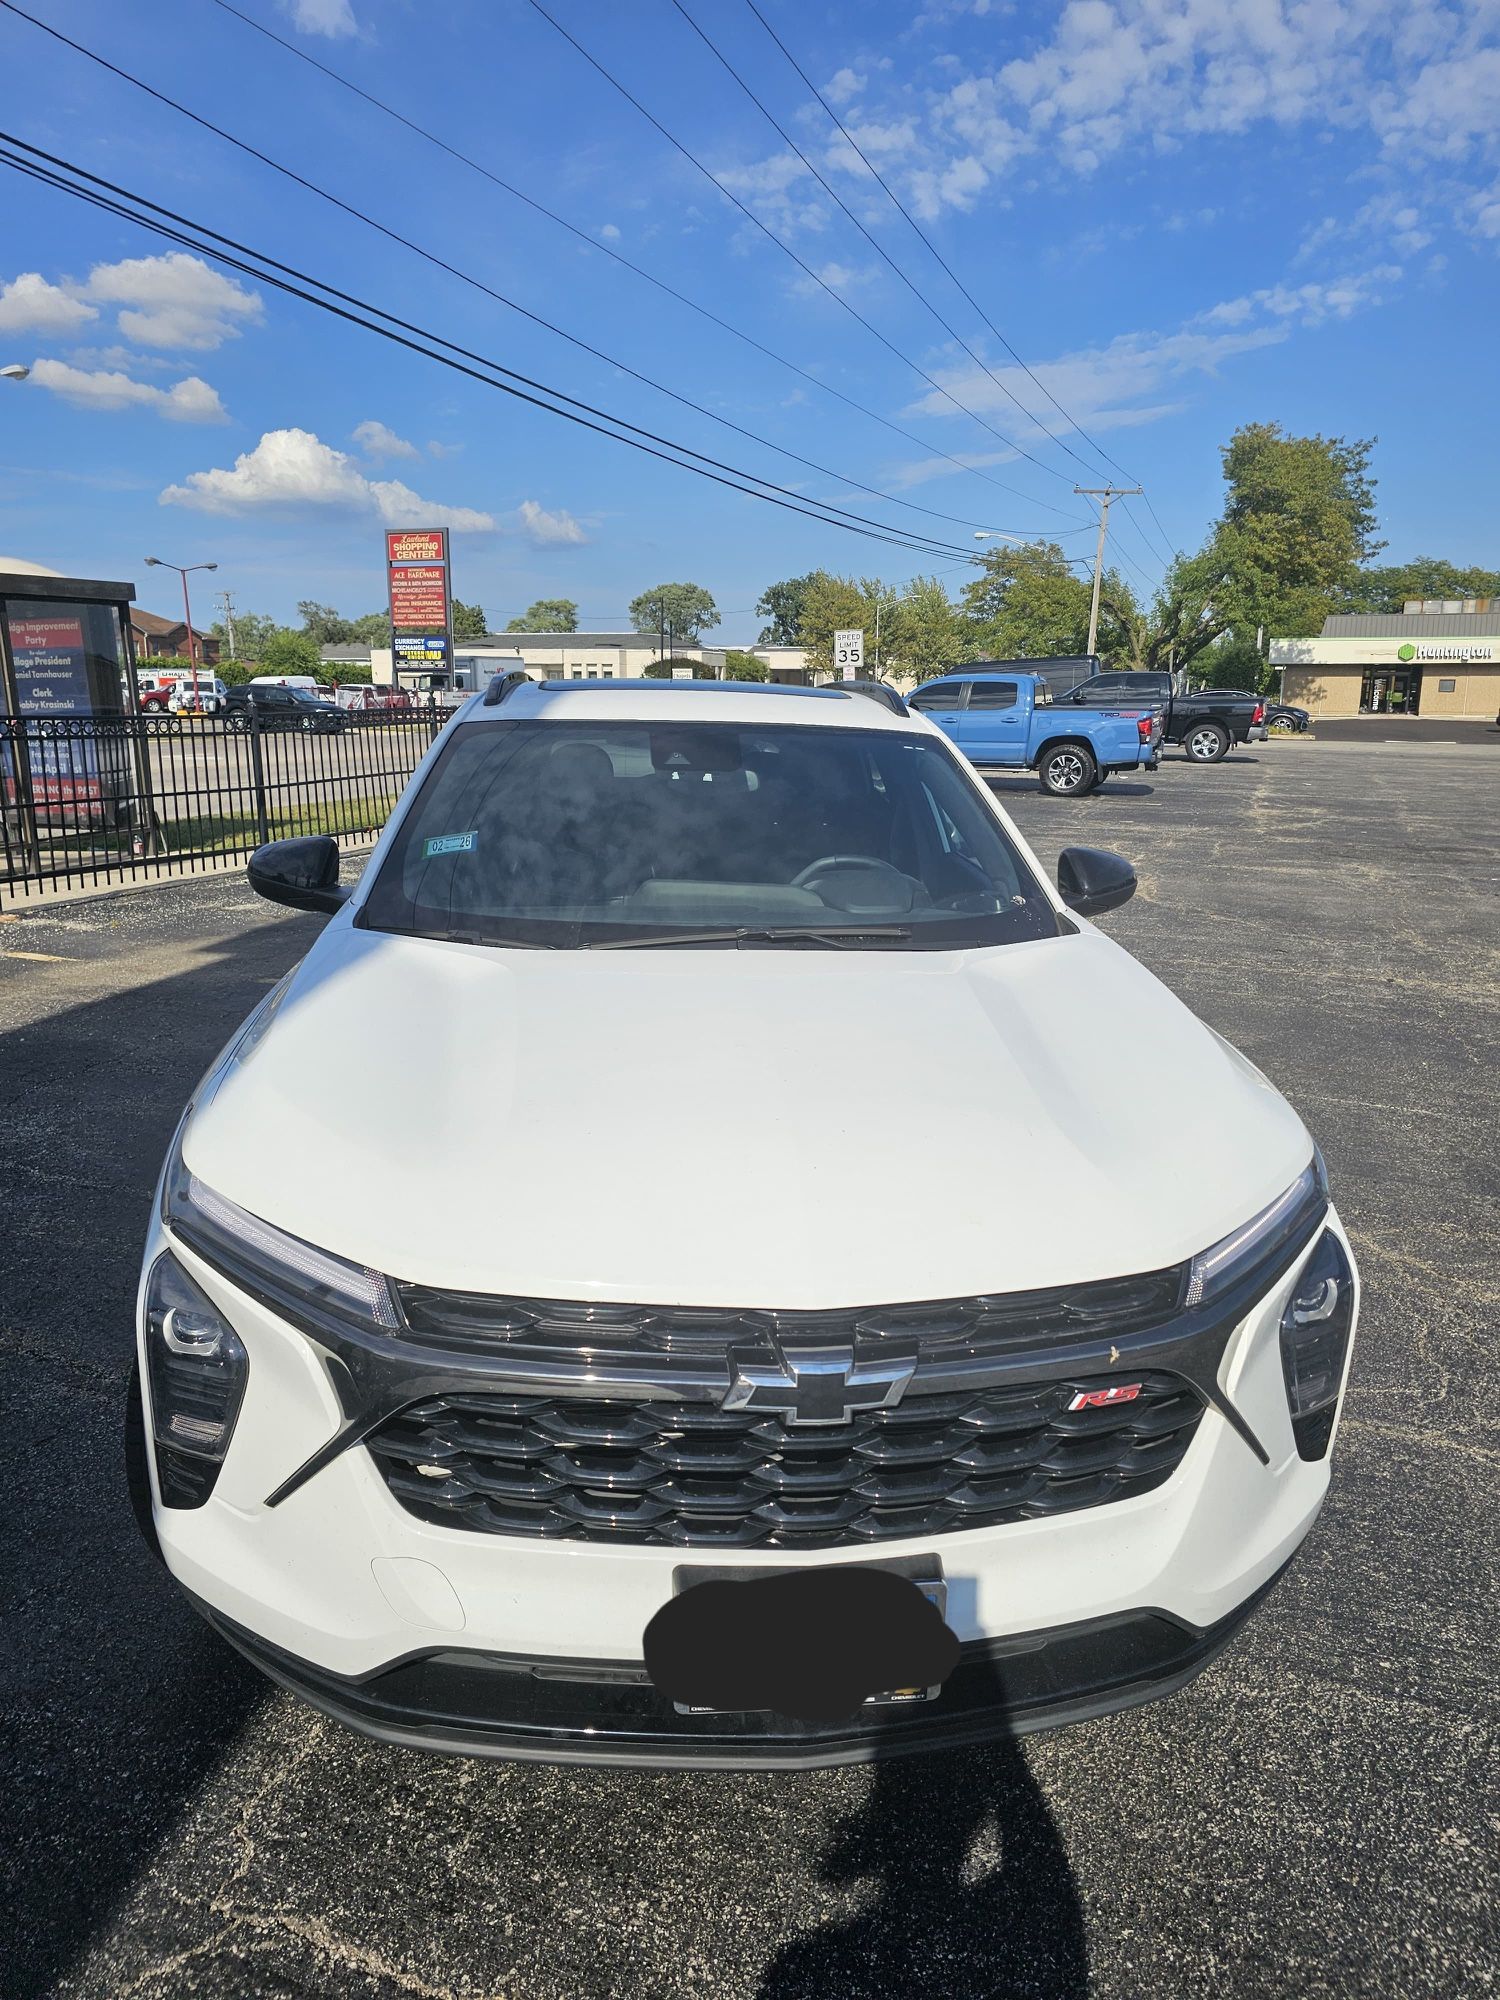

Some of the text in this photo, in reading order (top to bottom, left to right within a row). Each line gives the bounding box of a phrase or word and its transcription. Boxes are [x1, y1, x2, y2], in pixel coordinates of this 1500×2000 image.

[393, 542, 439, 551] SHOPPING
[396, 550, 436, 559] CENTER
[407, 571, 440, 579] HARDWARE
[9, 621, 79, 634] idge Improvement
[25, 636, 47, 646] Party
[839, 650, 860, 663] 35
[1416, 644, 1492, 663] Huntington
[13, 656, 72, 667] illage President
[15, 670, 72, 679] aniel Tannhauser
[32, 688, 53, 697] Clerk
[1372, 678, 1387, 711] Welcome
[19, 700, 75, 710] abby Krasinski
[44, 763, 67, 776] Apil
[432, 835, 471, 852] 02 26
[1067, 1382, 1143, 1411] RS
